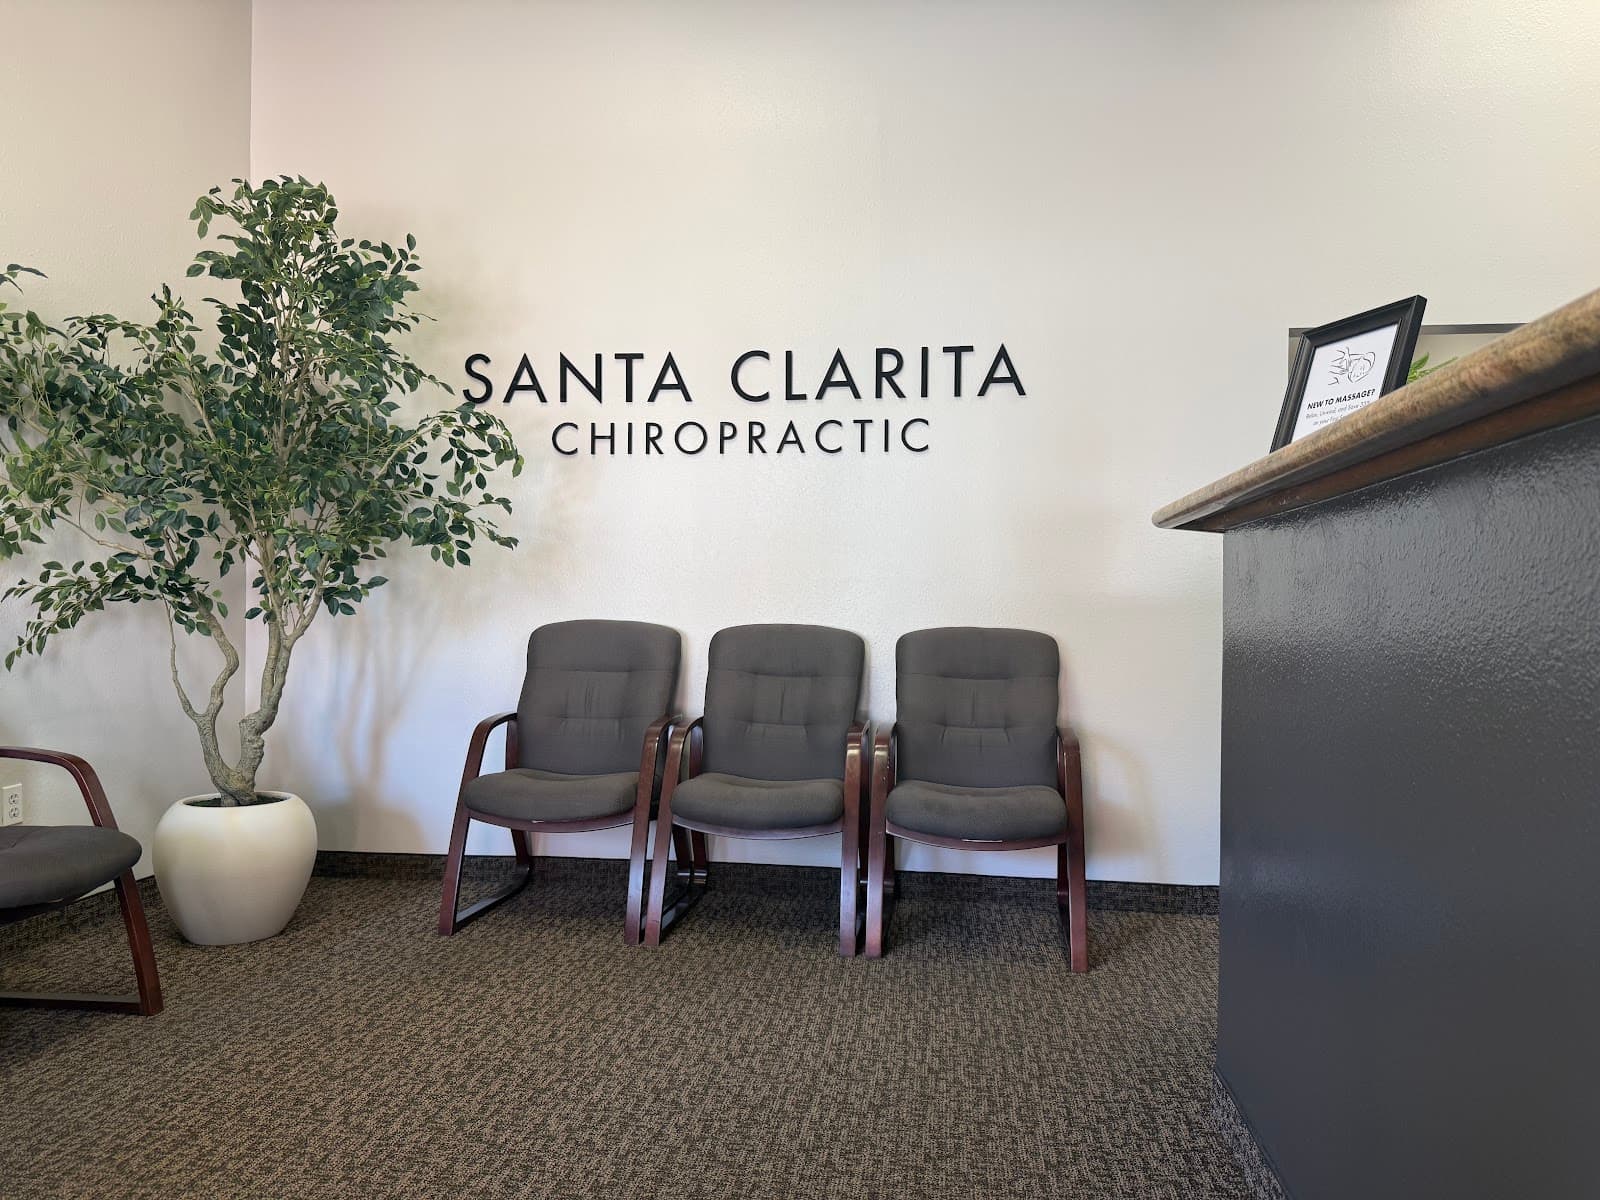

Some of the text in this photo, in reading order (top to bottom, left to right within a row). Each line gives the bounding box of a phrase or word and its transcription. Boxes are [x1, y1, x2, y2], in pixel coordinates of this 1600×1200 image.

[463, 343, 1027, 405] SANTA CLARITA
[1307, 388, 1376, 410] NEW TO MASSAGE?
[552, 418, 930, 456] CHIROPRACTIC
